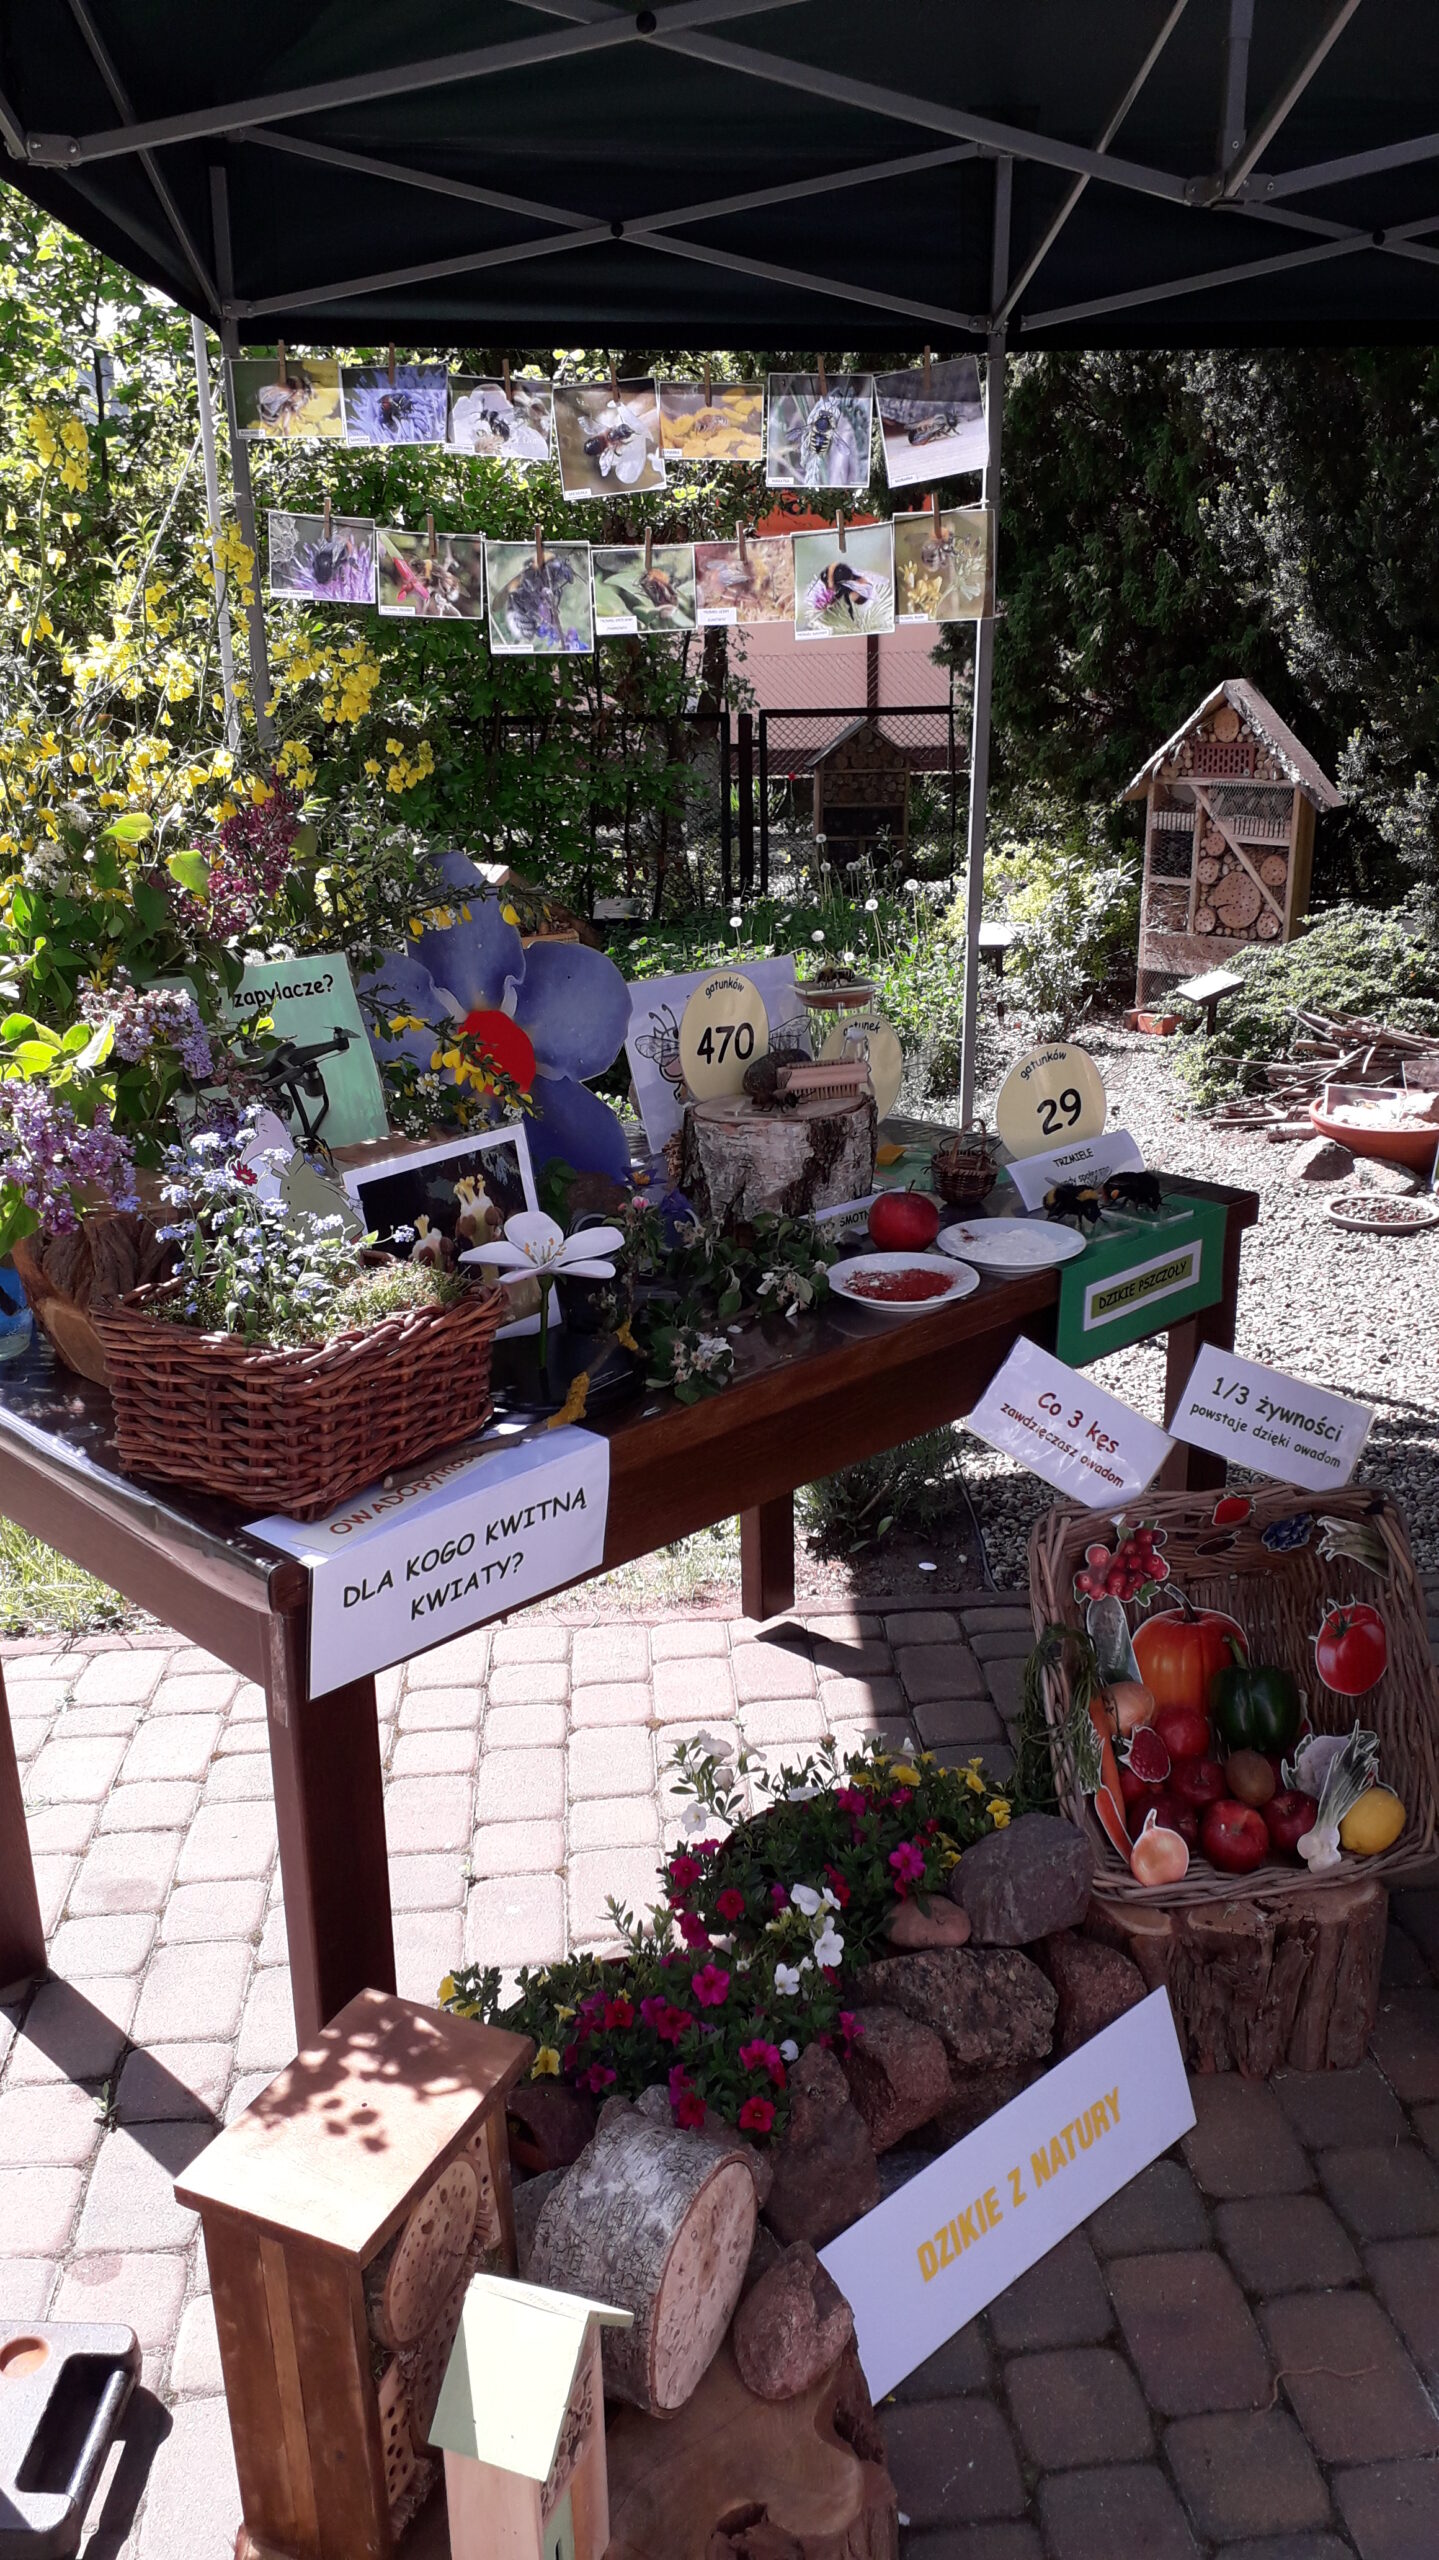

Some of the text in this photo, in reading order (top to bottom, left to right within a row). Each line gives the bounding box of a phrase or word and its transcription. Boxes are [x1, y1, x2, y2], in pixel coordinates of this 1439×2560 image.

[705, 977, 745, 999] gatunków
[697, 1022, 754, 1064] 470
[1020, 1048, 1067, 1081] gatunków
[1037, 1088, 1081, 1135] 29
[1052, 1148, 1094, 1168] TRZMIELE
[1098, 1261, 1187, 1310] DZIKIE PSZCZOŁY
[1038, 1392, 1119, 1454] Co 3 kęs
[1189, 1403, 1341, 1468] powstaje dzięki owadom
[1212, 1377, 1344, 1442] 1/3 żywności
[1000, 1403, 1124, 1488] zawdzięczasz owadom
[343, 1487, 588, 1608] DLA KOGO KWITNĄ
[411, 1551, 524, 1621] KWIATY?
[916, 2086, 1121, 2284] DZIKIE Z NATURY
